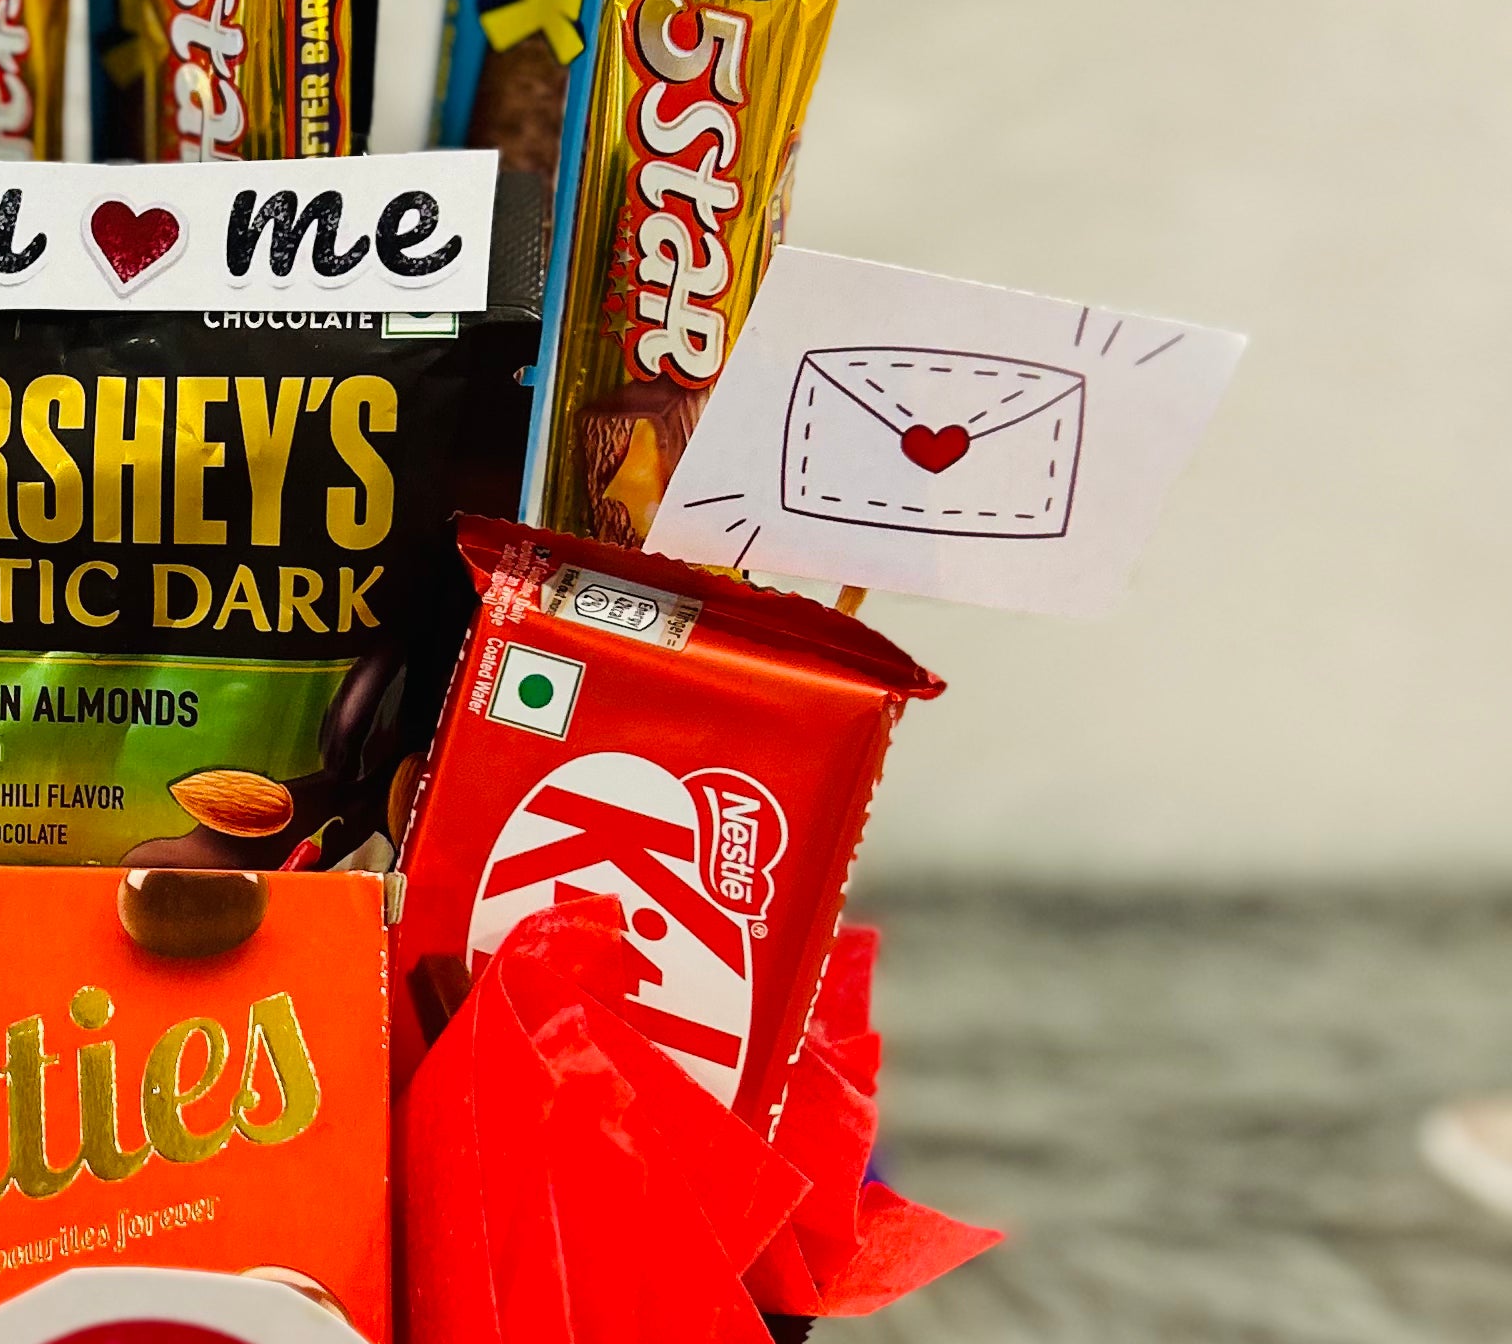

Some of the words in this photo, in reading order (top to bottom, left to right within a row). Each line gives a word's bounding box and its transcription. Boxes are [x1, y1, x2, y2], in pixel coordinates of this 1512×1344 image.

[301, 73, 330, 158] FTER
[226, 189, 464, 278] me
[203, 310, 374, 329] CHOCOLATE
[152, 563, 385, 634] DARK
[479, 637, 505, 680] Coated
[32, 687, 199, 728] ALMONDS
[467, 680, 493, 716] Wafer
[47, 783, 125, 812] FLAVOR
[113, 1196, 221, 1253] forever
